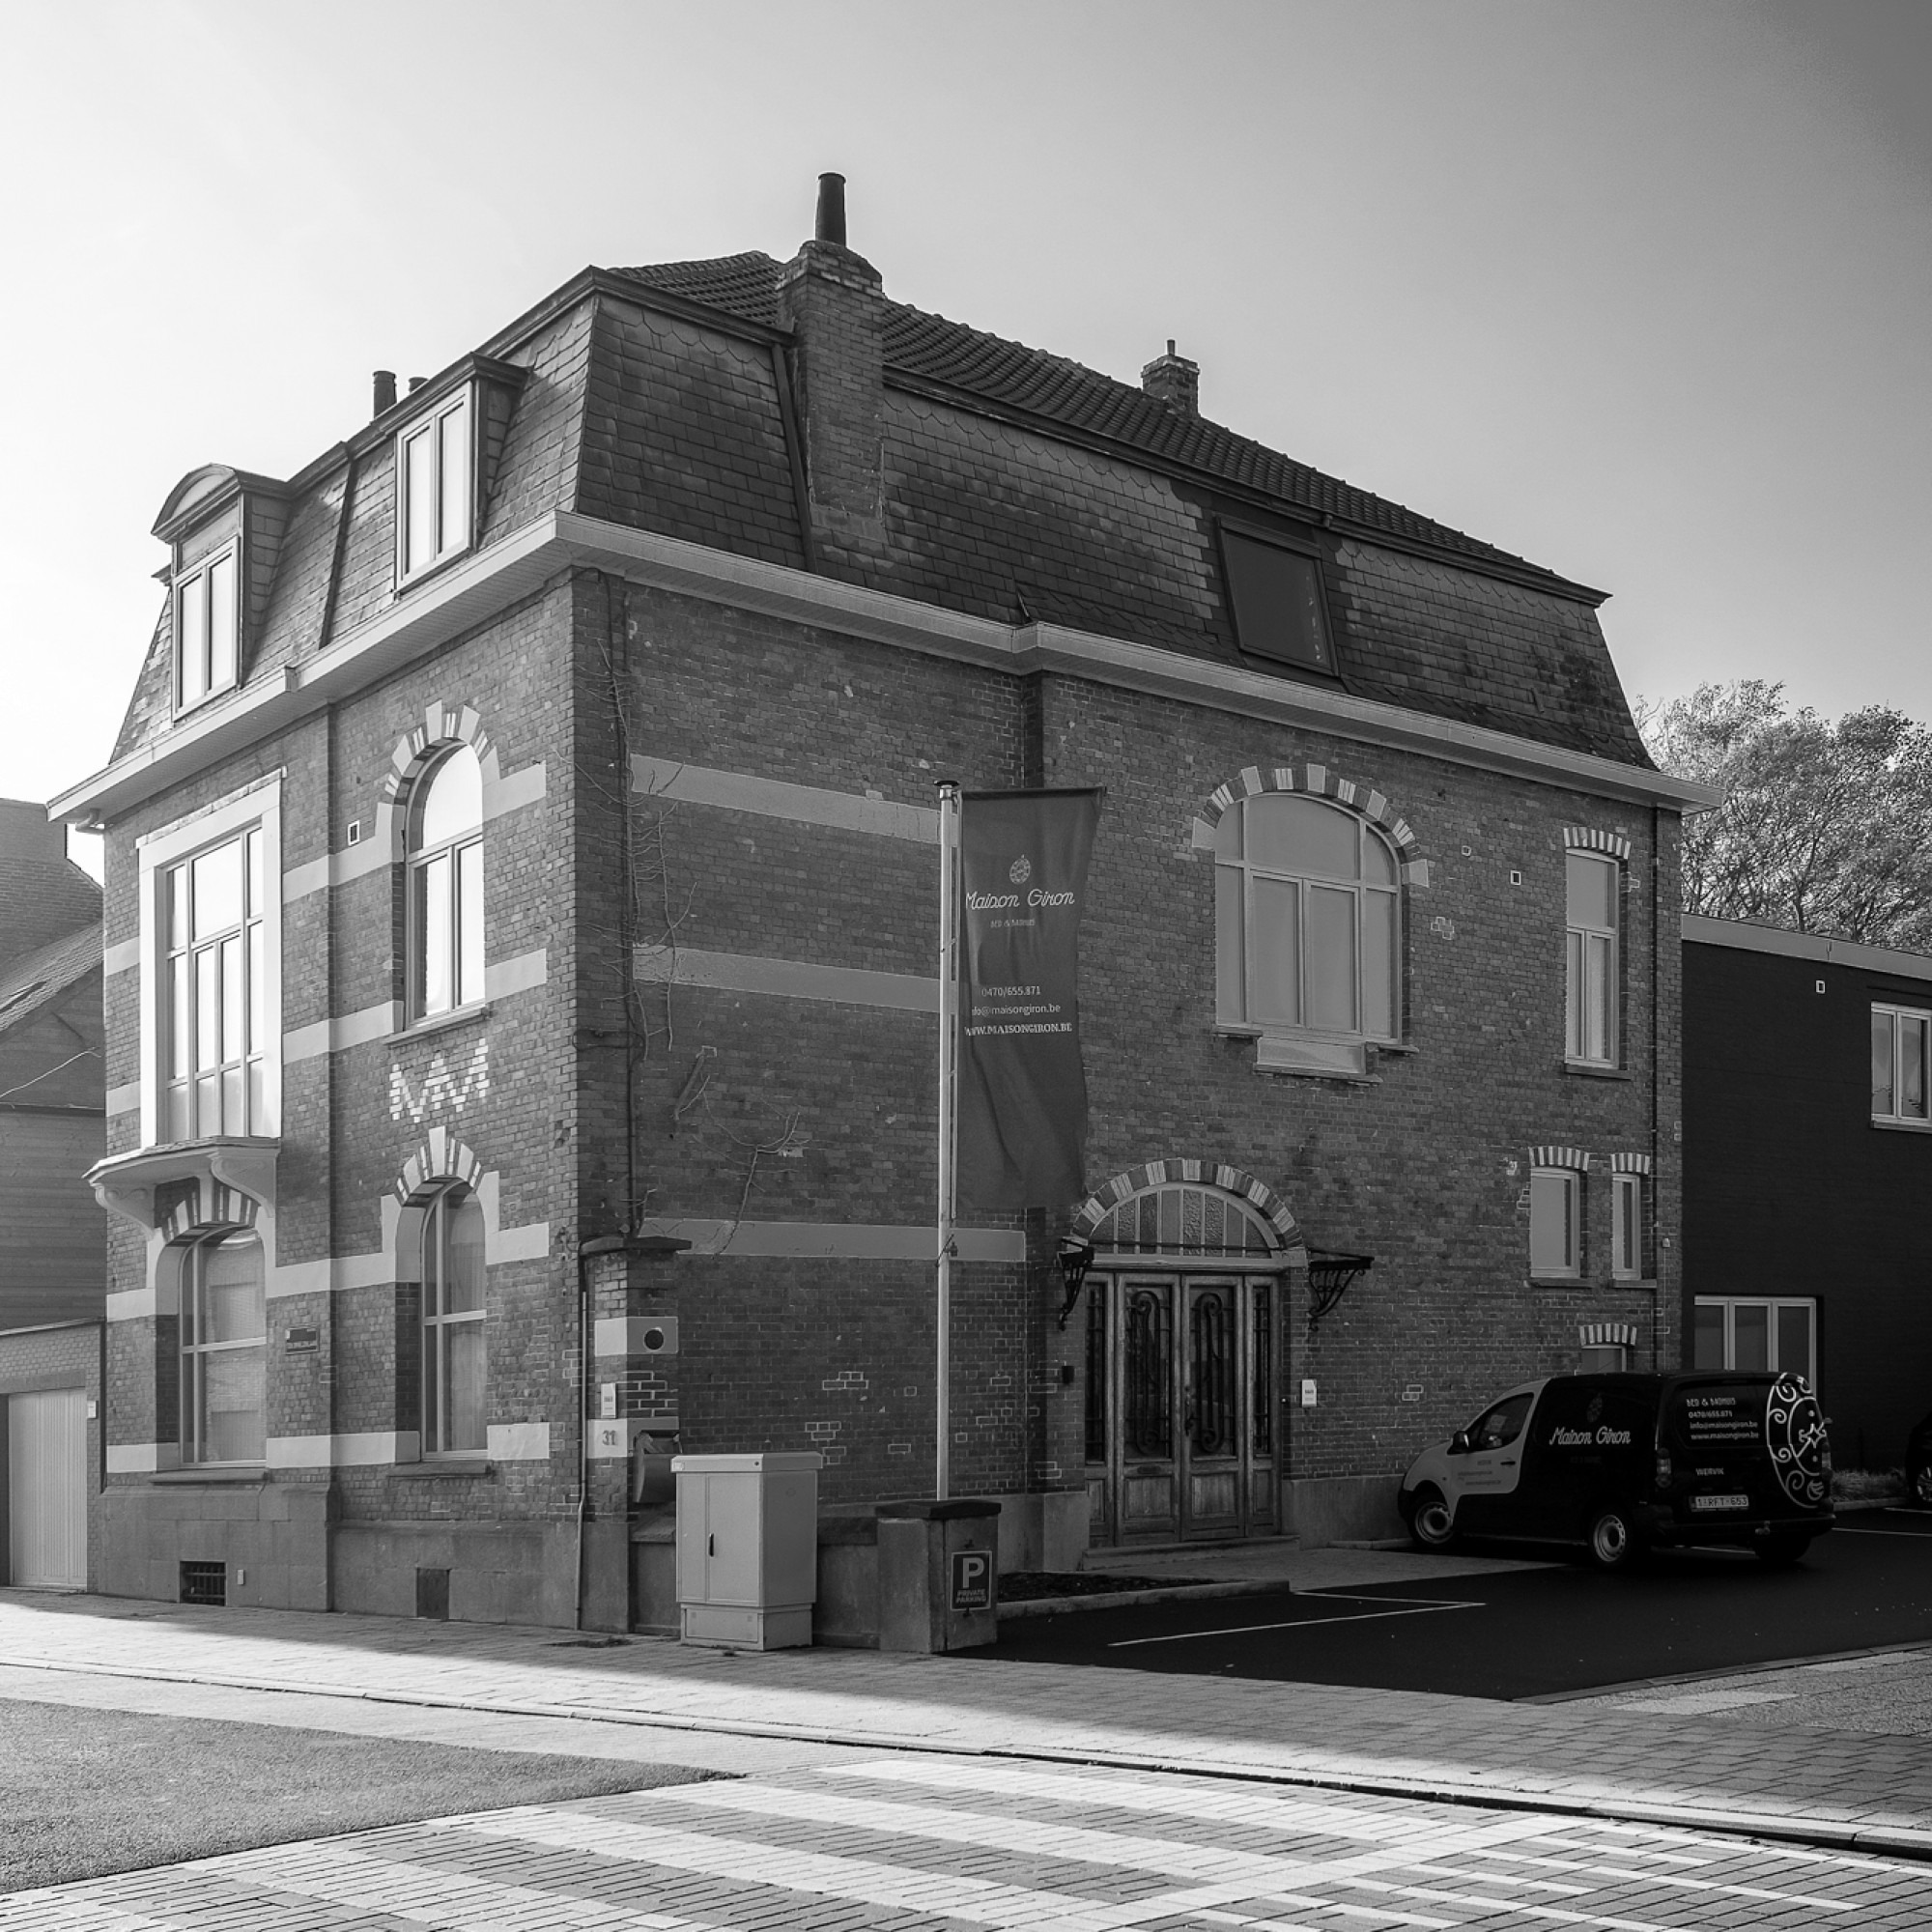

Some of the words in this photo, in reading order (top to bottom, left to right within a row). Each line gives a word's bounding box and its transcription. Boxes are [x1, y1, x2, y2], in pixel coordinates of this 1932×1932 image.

[965, 891, 1020, 910] Maison
[1027, 888, 1075, 907] Giron
[602, 1430, 616, 1445] 31
[1548, 1426, 1592, 1445] Maison
[1596, 1425, 1632, 1444] Giron
[962, 1557, 984, 1588] P
